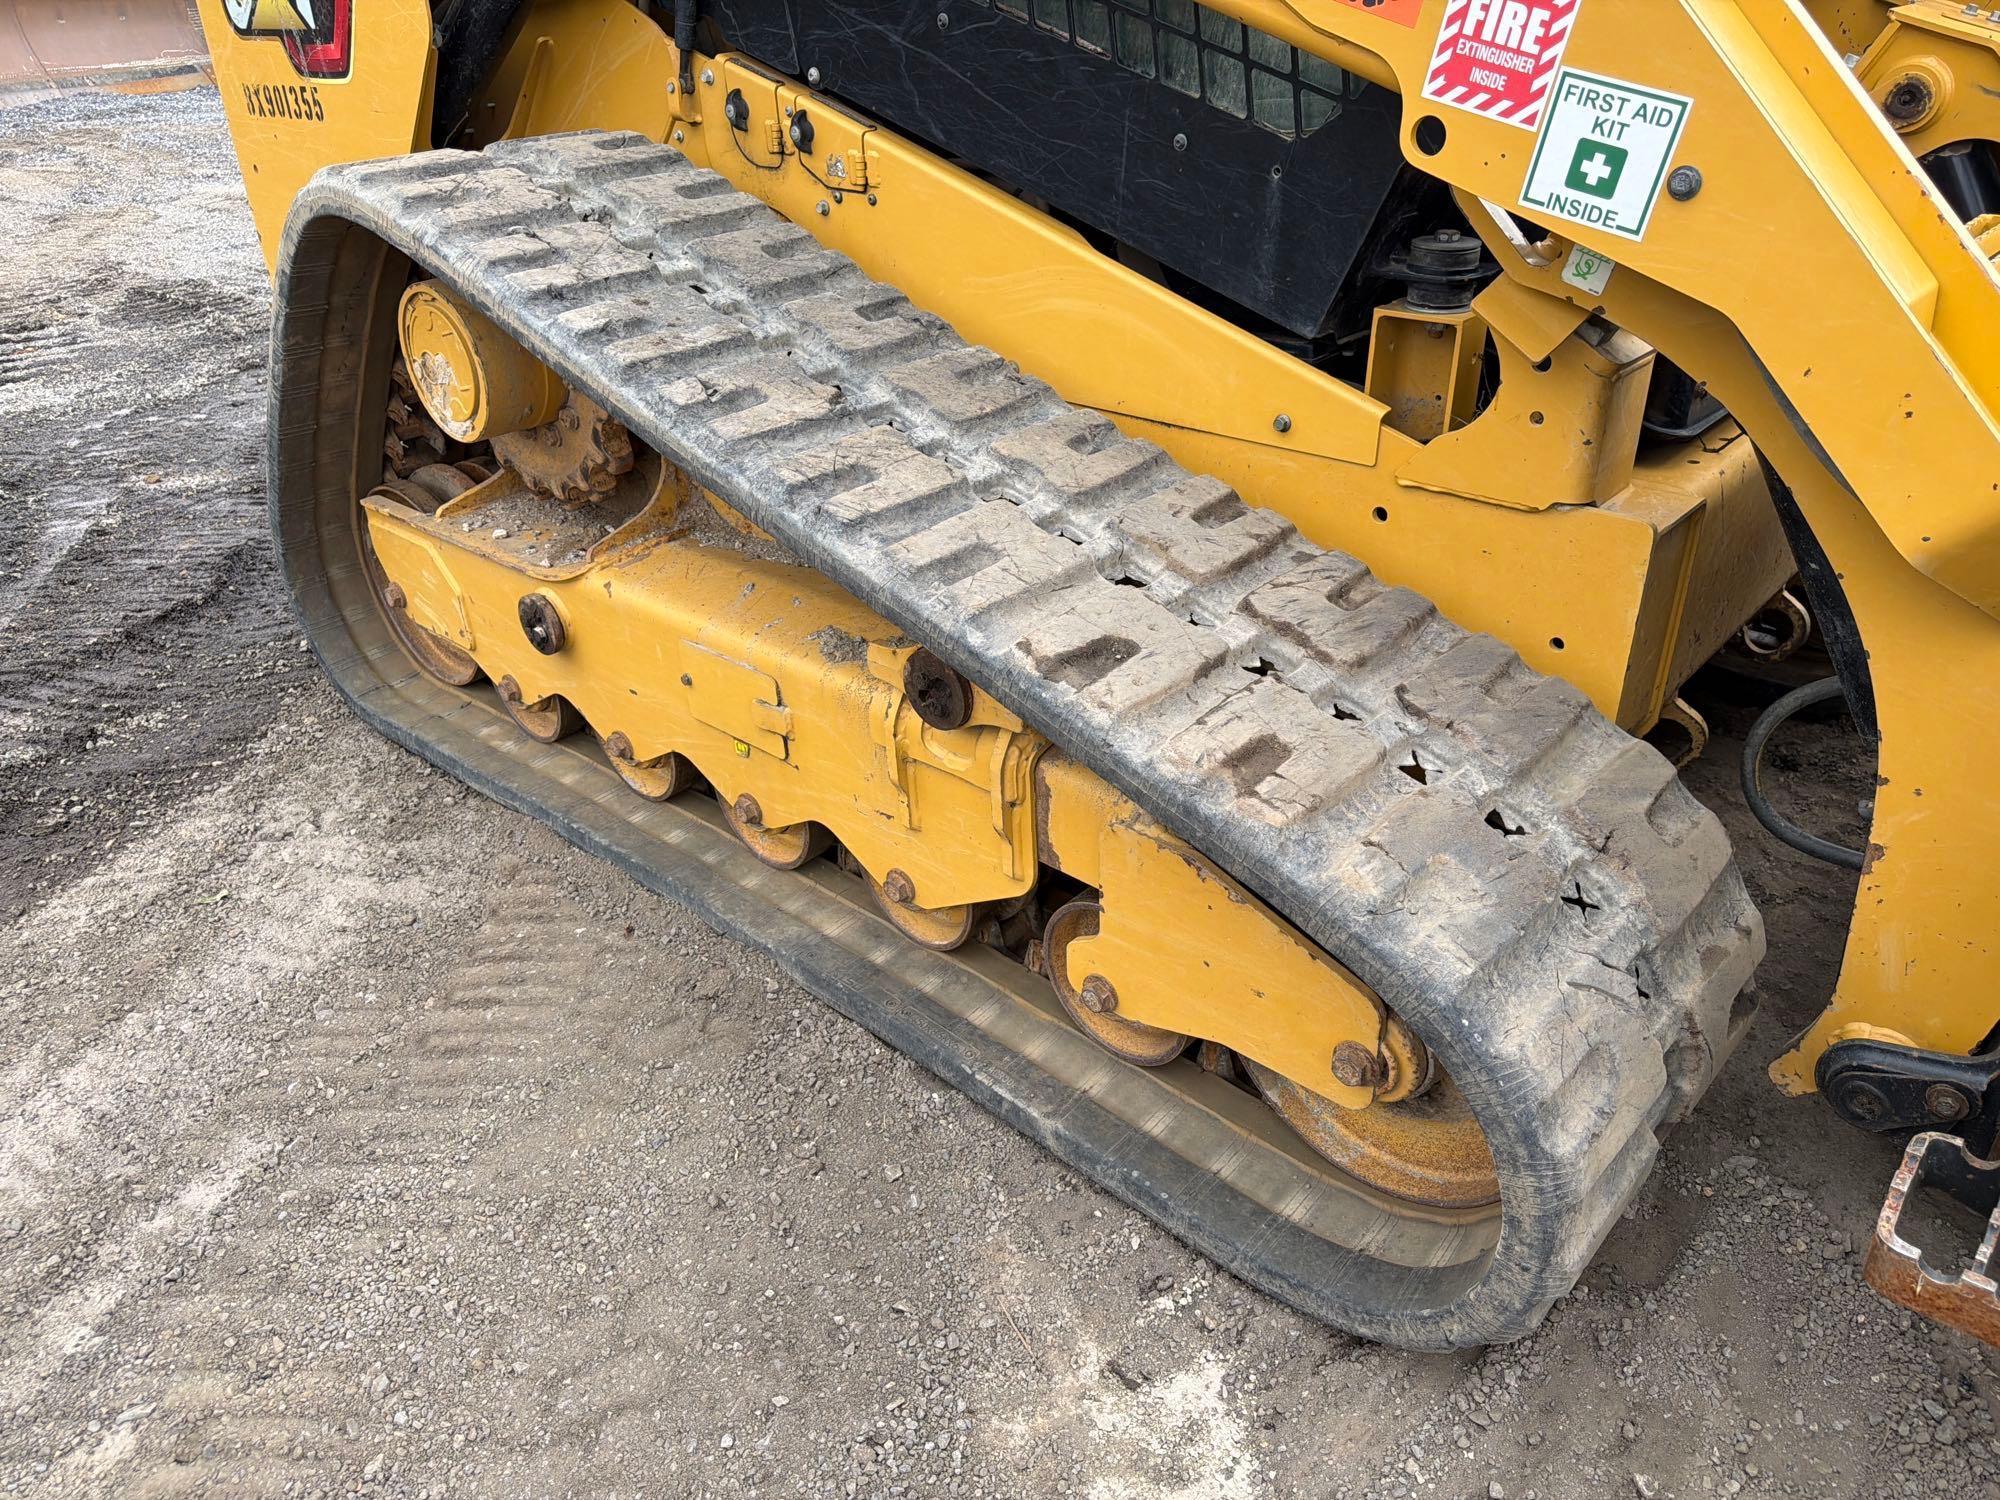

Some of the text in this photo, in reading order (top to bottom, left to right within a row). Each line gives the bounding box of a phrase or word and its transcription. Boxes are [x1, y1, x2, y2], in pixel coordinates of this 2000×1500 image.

[1462, 0, 1551, 55] FIRE
[1456, 38, 1535, 75] EXTINGUISHER
[1469, 66, 1507, 91] INSIDE
[1563, 83, 1673, 128] FIRST AID
[1591, 116, 1630, 141] KIT
[1546, 192, 1619, 229] INSIDE
